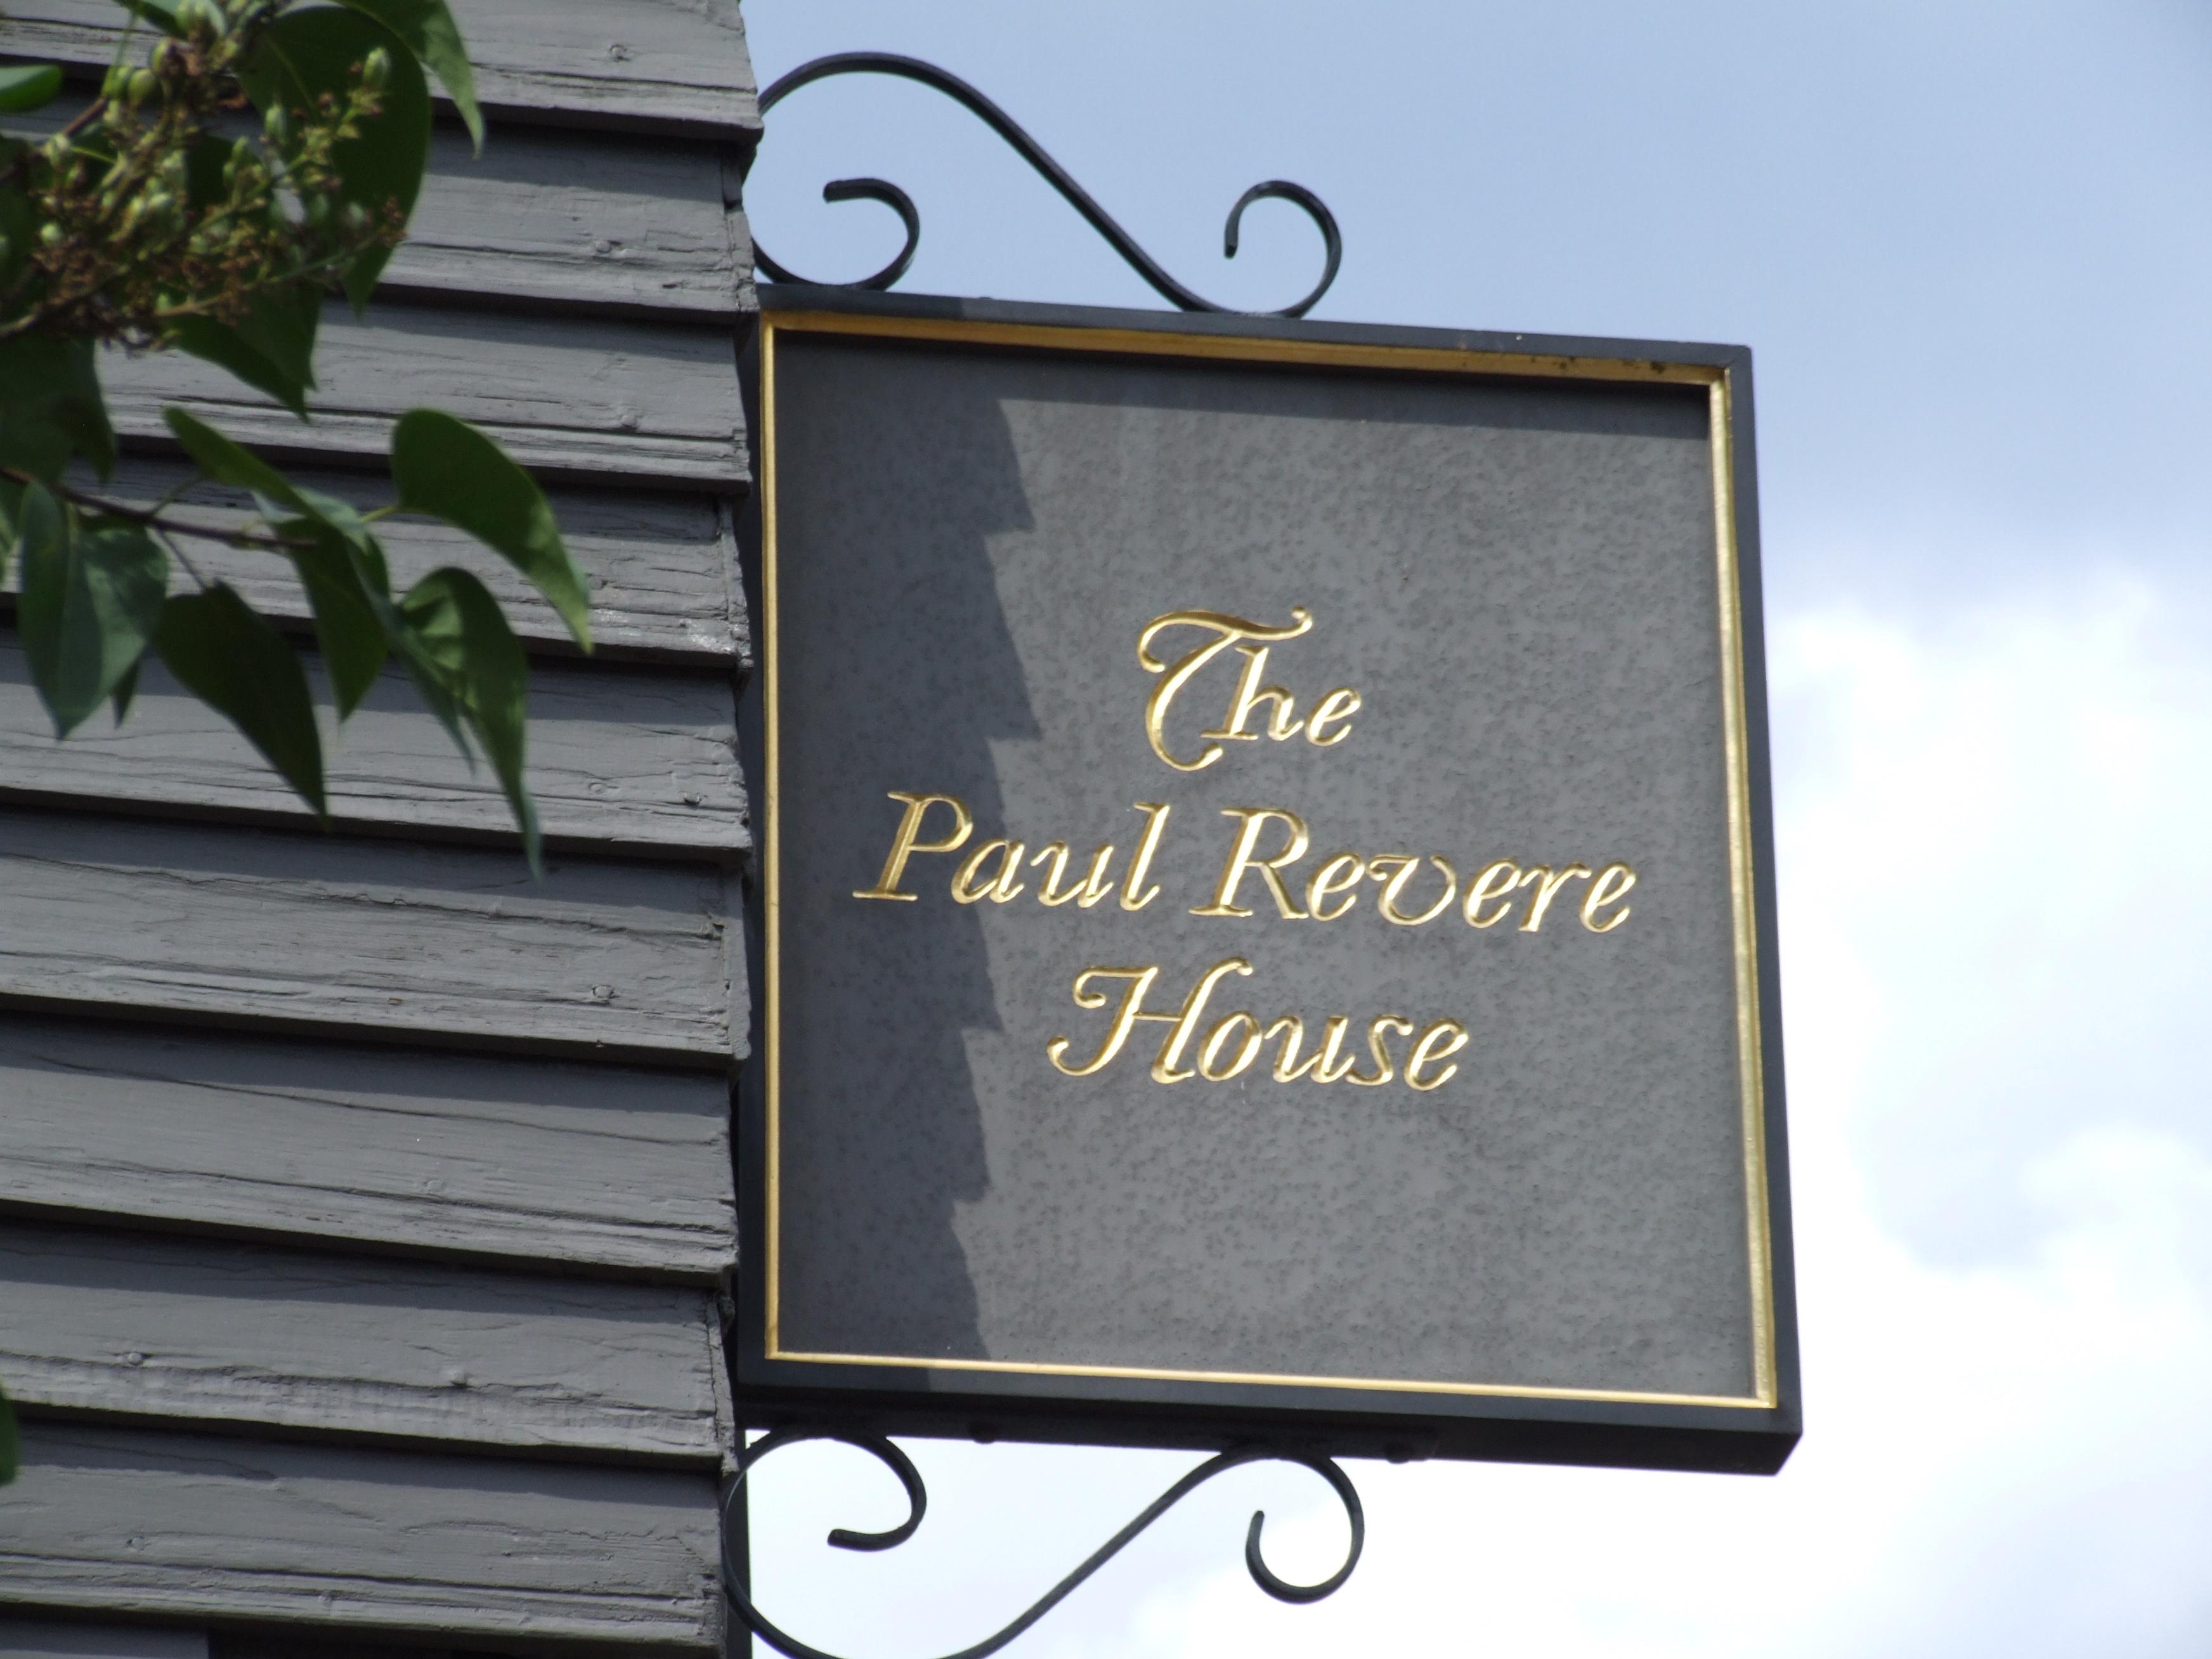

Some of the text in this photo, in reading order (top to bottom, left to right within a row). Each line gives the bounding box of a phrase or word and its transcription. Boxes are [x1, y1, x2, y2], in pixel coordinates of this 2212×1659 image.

[1136, 606, 1363, 772] The
[852, 791, 1637, 934] Paul Revere
[1046, 956, 1470, 1091] House
